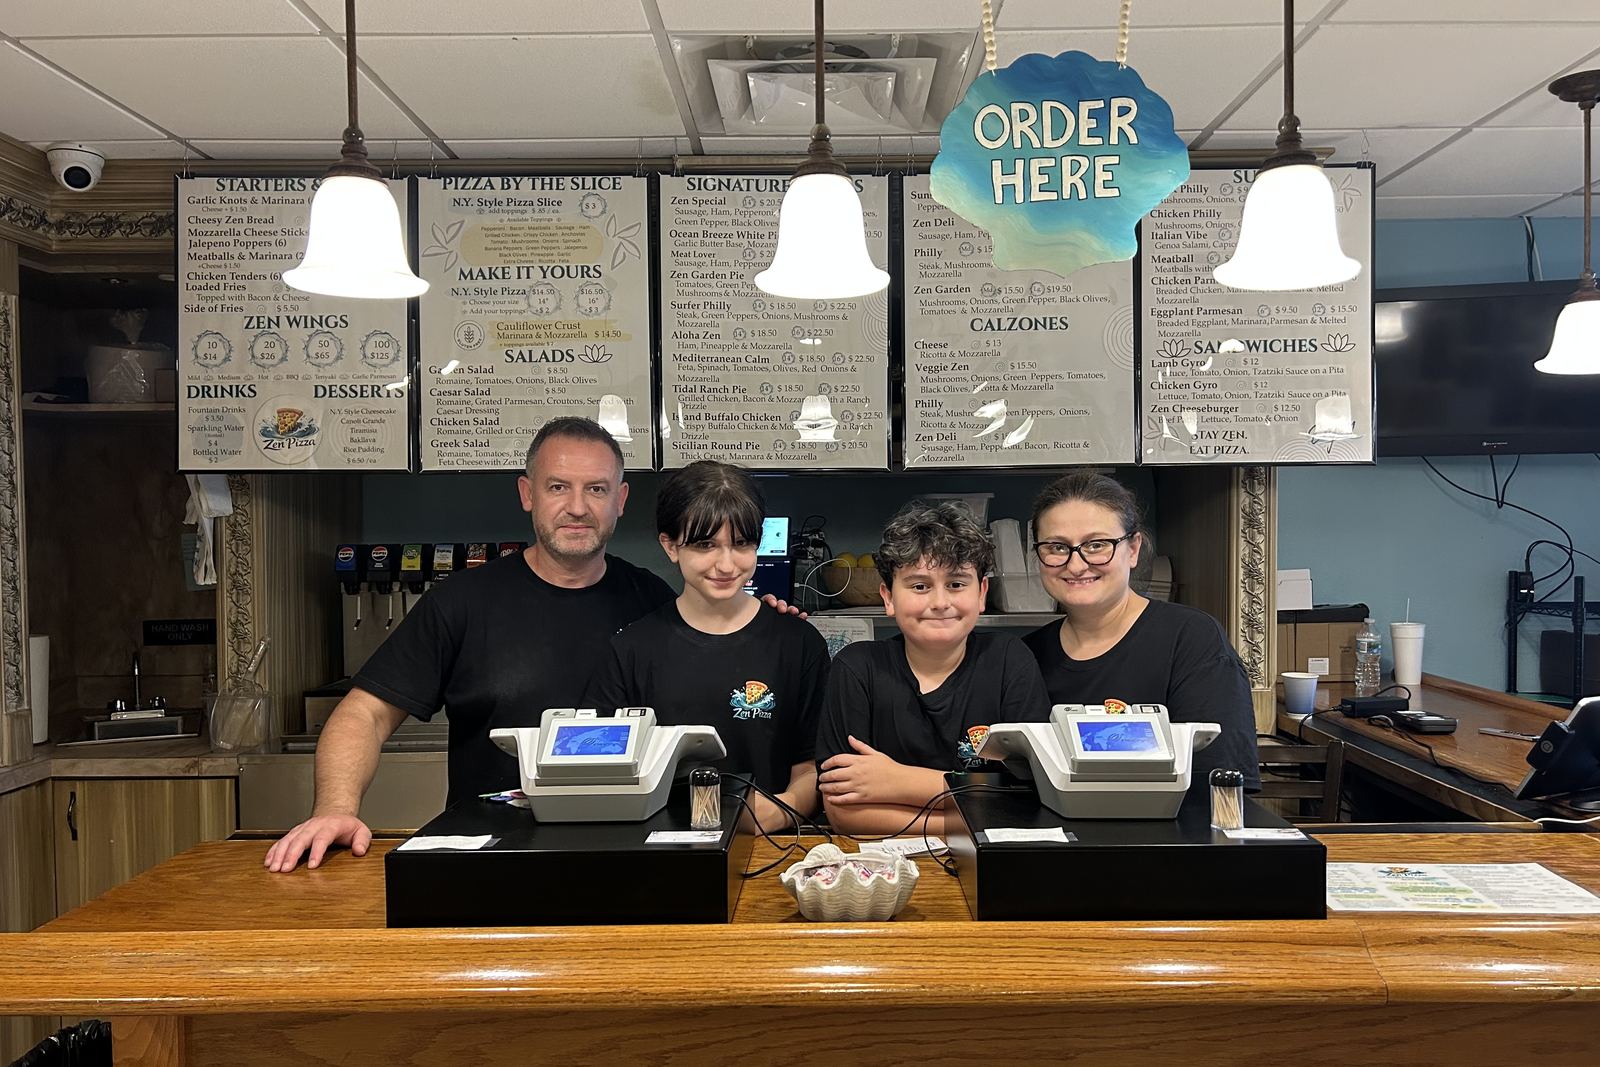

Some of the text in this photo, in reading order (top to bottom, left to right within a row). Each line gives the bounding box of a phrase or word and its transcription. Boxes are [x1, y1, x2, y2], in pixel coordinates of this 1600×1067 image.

[973, 97, 1139, 149] ORDER
[216, 178, 306, 191] STARTERS
[442, 177, 622, 191] PIZZA BY THE SLICE
[991, 155, 1120, 205] HERE
[687, 178, 790, 192] SIGNATURE
[188, 196, 216, 205] Garlic
[219, 196, 247, 204] Knots
[262, 196, 305, 204] Marinara
[453, 198, 562, 208] N.Y. Style Pizza Slice
[671, 197, 726, 206] Zen Special
[1150, 210, 1221, 219] Chicken Philly
[188, 216, 274, 225] Cheesy Zen Bread
[913, 218, 954, 227] Zen Deli
[188, 228, 241, 237] Mozzarella
[244, 228, 278, 237] Cheese
[670, 230, 765, 239] Ocean Breeze White
[1151, 231, 1207, 239] Italian Vibe
[189, 239, 286, 250] Jalepeno Poppers (6)
[188, 252, 293, 261] Meatballs & Marinara
[914, 249, 942, 259] Philly
[1151, 255, 1194, 264] Meatball
[187, 272, 282, 281] Chicken Tenders (6)
[459, 265, 602, 281] MAKE IT YOURS
[670, 271, 744, 280] Zen Garden Pie
[186, 283, 246, 291] Loaded Fries
[914, 285, 971, 294] Zen Garden
[1047, 285, 1071, 293] $19.50
[451, 287, 526, 297] N.Y. Style Pizza
[184, 304, 243, 313] Side of Fries
[671, 301, 732, 312] Surfer Philly
[1151, 307, 1242, 318] Eggplant Parmesan
[244, 315, 349, 329] ZEN WINGS
[496, 322, 580, 331] Cauliflower Crust
[970, 317, 1068, 332] CALZONES
[264, 341, 275, 349] 20
[318, 340, 329, 348] 50
[374, 340, 390, 348] 100
[914, 341, 948, 349] Cheese
[1194, 339, 1317, 354] SAWICHES
[203, 353, 217, 361] $14
[315, 352, 330, 360] $65
[370, 352, 389, 360] $125
[505, 349, 574, 363] SALADS
[672, 354, 769, 363] Mediterranean Calm
[915, 363, 969, 374] Veggie Zen
[1151, 359, 1206, 370] Lamb Gyro
[429, 365, 493, 374] Gaen Salad
[436, 377, 472, 386] Romaine,
[475, 377, 514, 386] Tomatoes,
[672, 385, 747, 394] Tidal Ranch Pie
[1151, 381, 1217, 392] Chicken Gyro
[187, 384, 256, 399] DRINKS
[314, 384, 404, 399] DESSERTS
[430, 388, 490, 396] Caesar Salad
[188, 406, 246, 414] Fountain Drinks
[915, 400, 943, 411] Philly
[1151, 403, 1239, 414] Zen Cheeseburger
[430, 417, 499, 426] Chicken Salad
[672, 413, 781, 422] Isand Buffalo Chicken
[188, 425, 222, 433] Sparkling
[915, 433, 956, 442] Zen Deli
[1222, 430, 1248, 441] ZEN.
[263, 437, 316, 451] Zen Pizza
[431, 439, 490, 448] Greek Salad
[672, 442, 760, 450] Sicilian Round Pie
[359, 446, 384, 455] Pudding
[1190, 446, 1249, 455] EAT PIZZA.
[703, 453, 727, 461] Crust,
[775, 453, 817, 461] Mozzarella
[732, 708, 772, 720] Zen Pizza
